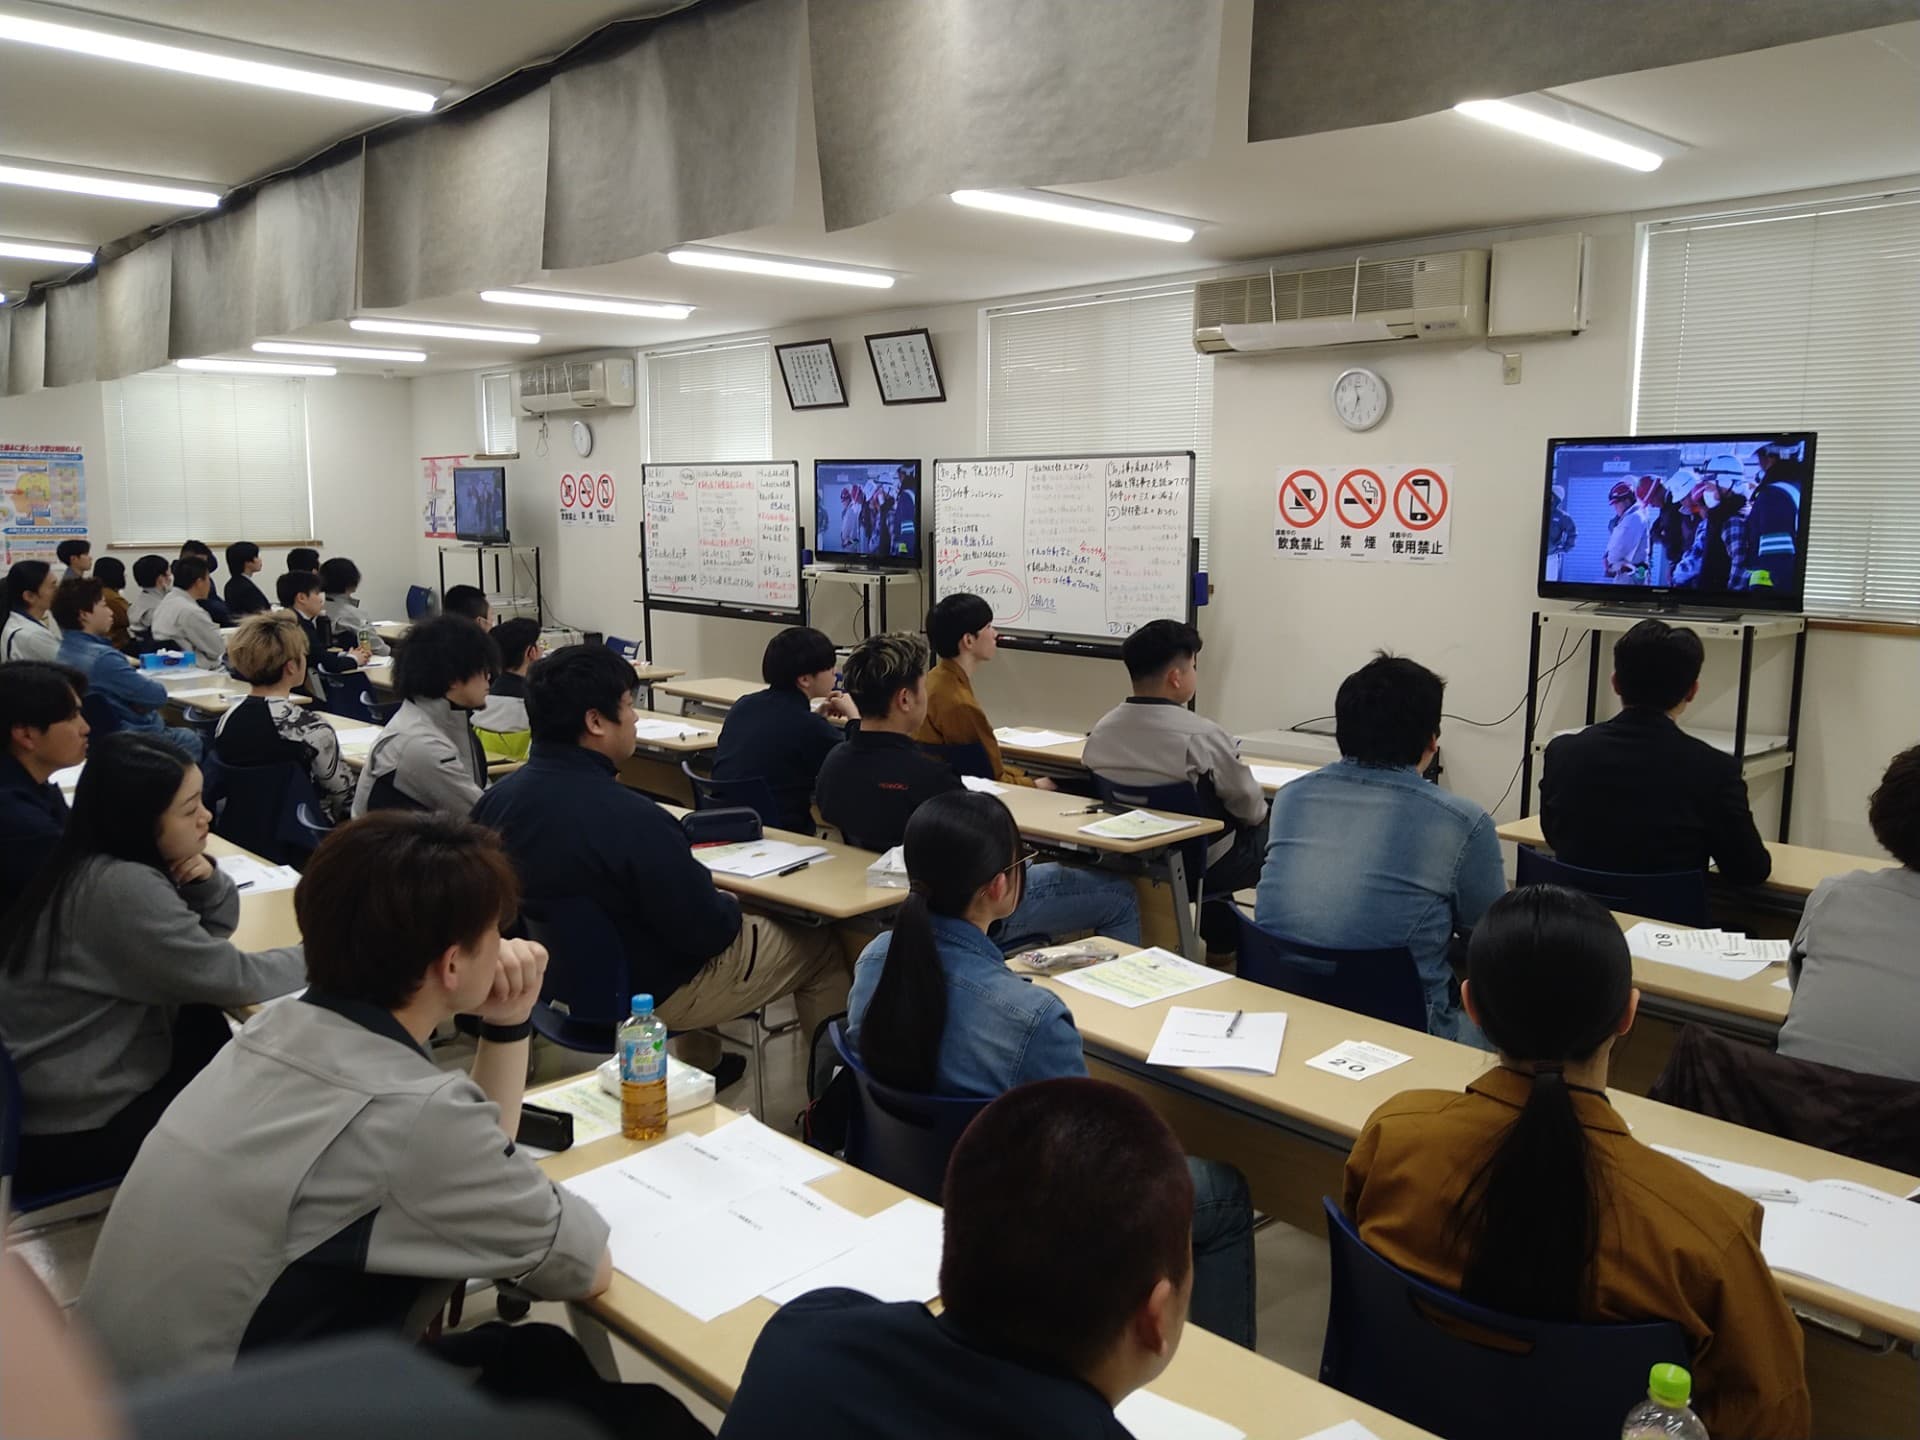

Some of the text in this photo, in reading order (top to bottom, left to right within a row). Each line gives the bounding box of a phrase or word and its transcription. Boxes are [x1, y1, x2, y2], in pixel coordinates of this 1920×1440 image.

[1278, 536, 1324, 550] 飲食禁止
[1391, 539, 1444, 554] 使用禁止
[1328, 1058, 1366, 1072] 20
